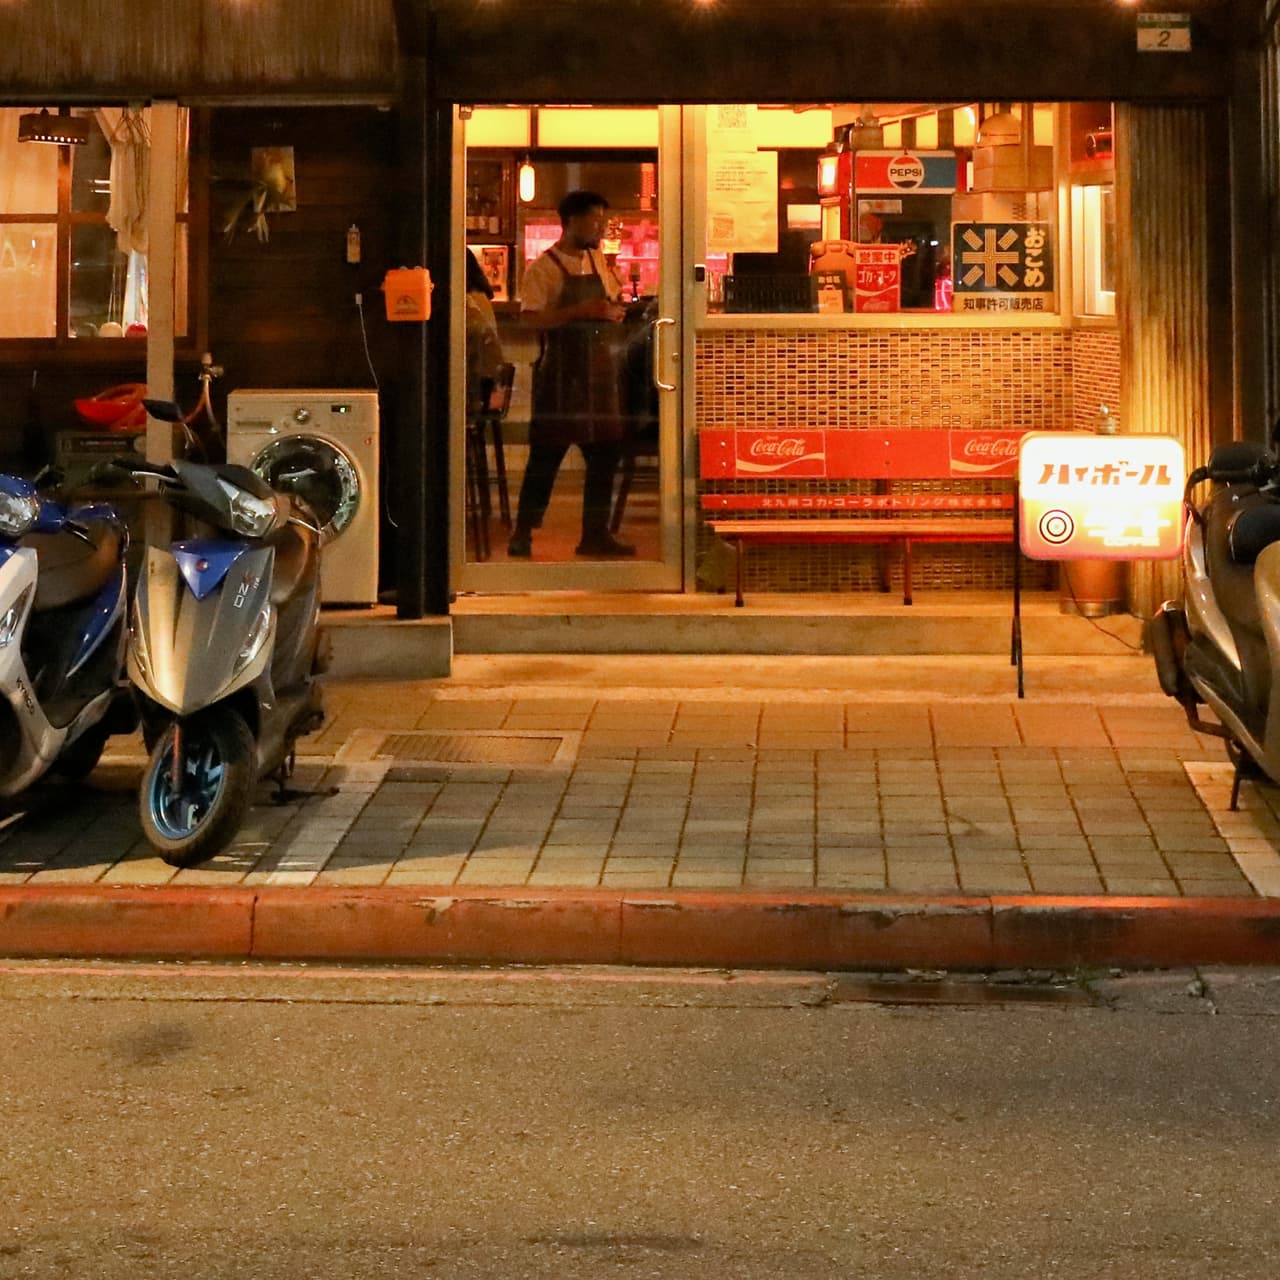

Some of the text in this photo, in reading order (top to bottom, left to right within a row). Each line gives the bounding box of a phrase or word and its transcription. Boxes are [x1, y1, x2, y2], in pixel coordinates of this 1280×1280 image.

[1157, 30, 1171, 48] 2
[890, 168, 922, 177] PEPSI
[1024, 227, 1045, 288] おこめ
[750, 438, 807, 456] Coca-Cola
[1038, 460, 1172, 485] ハイボール
